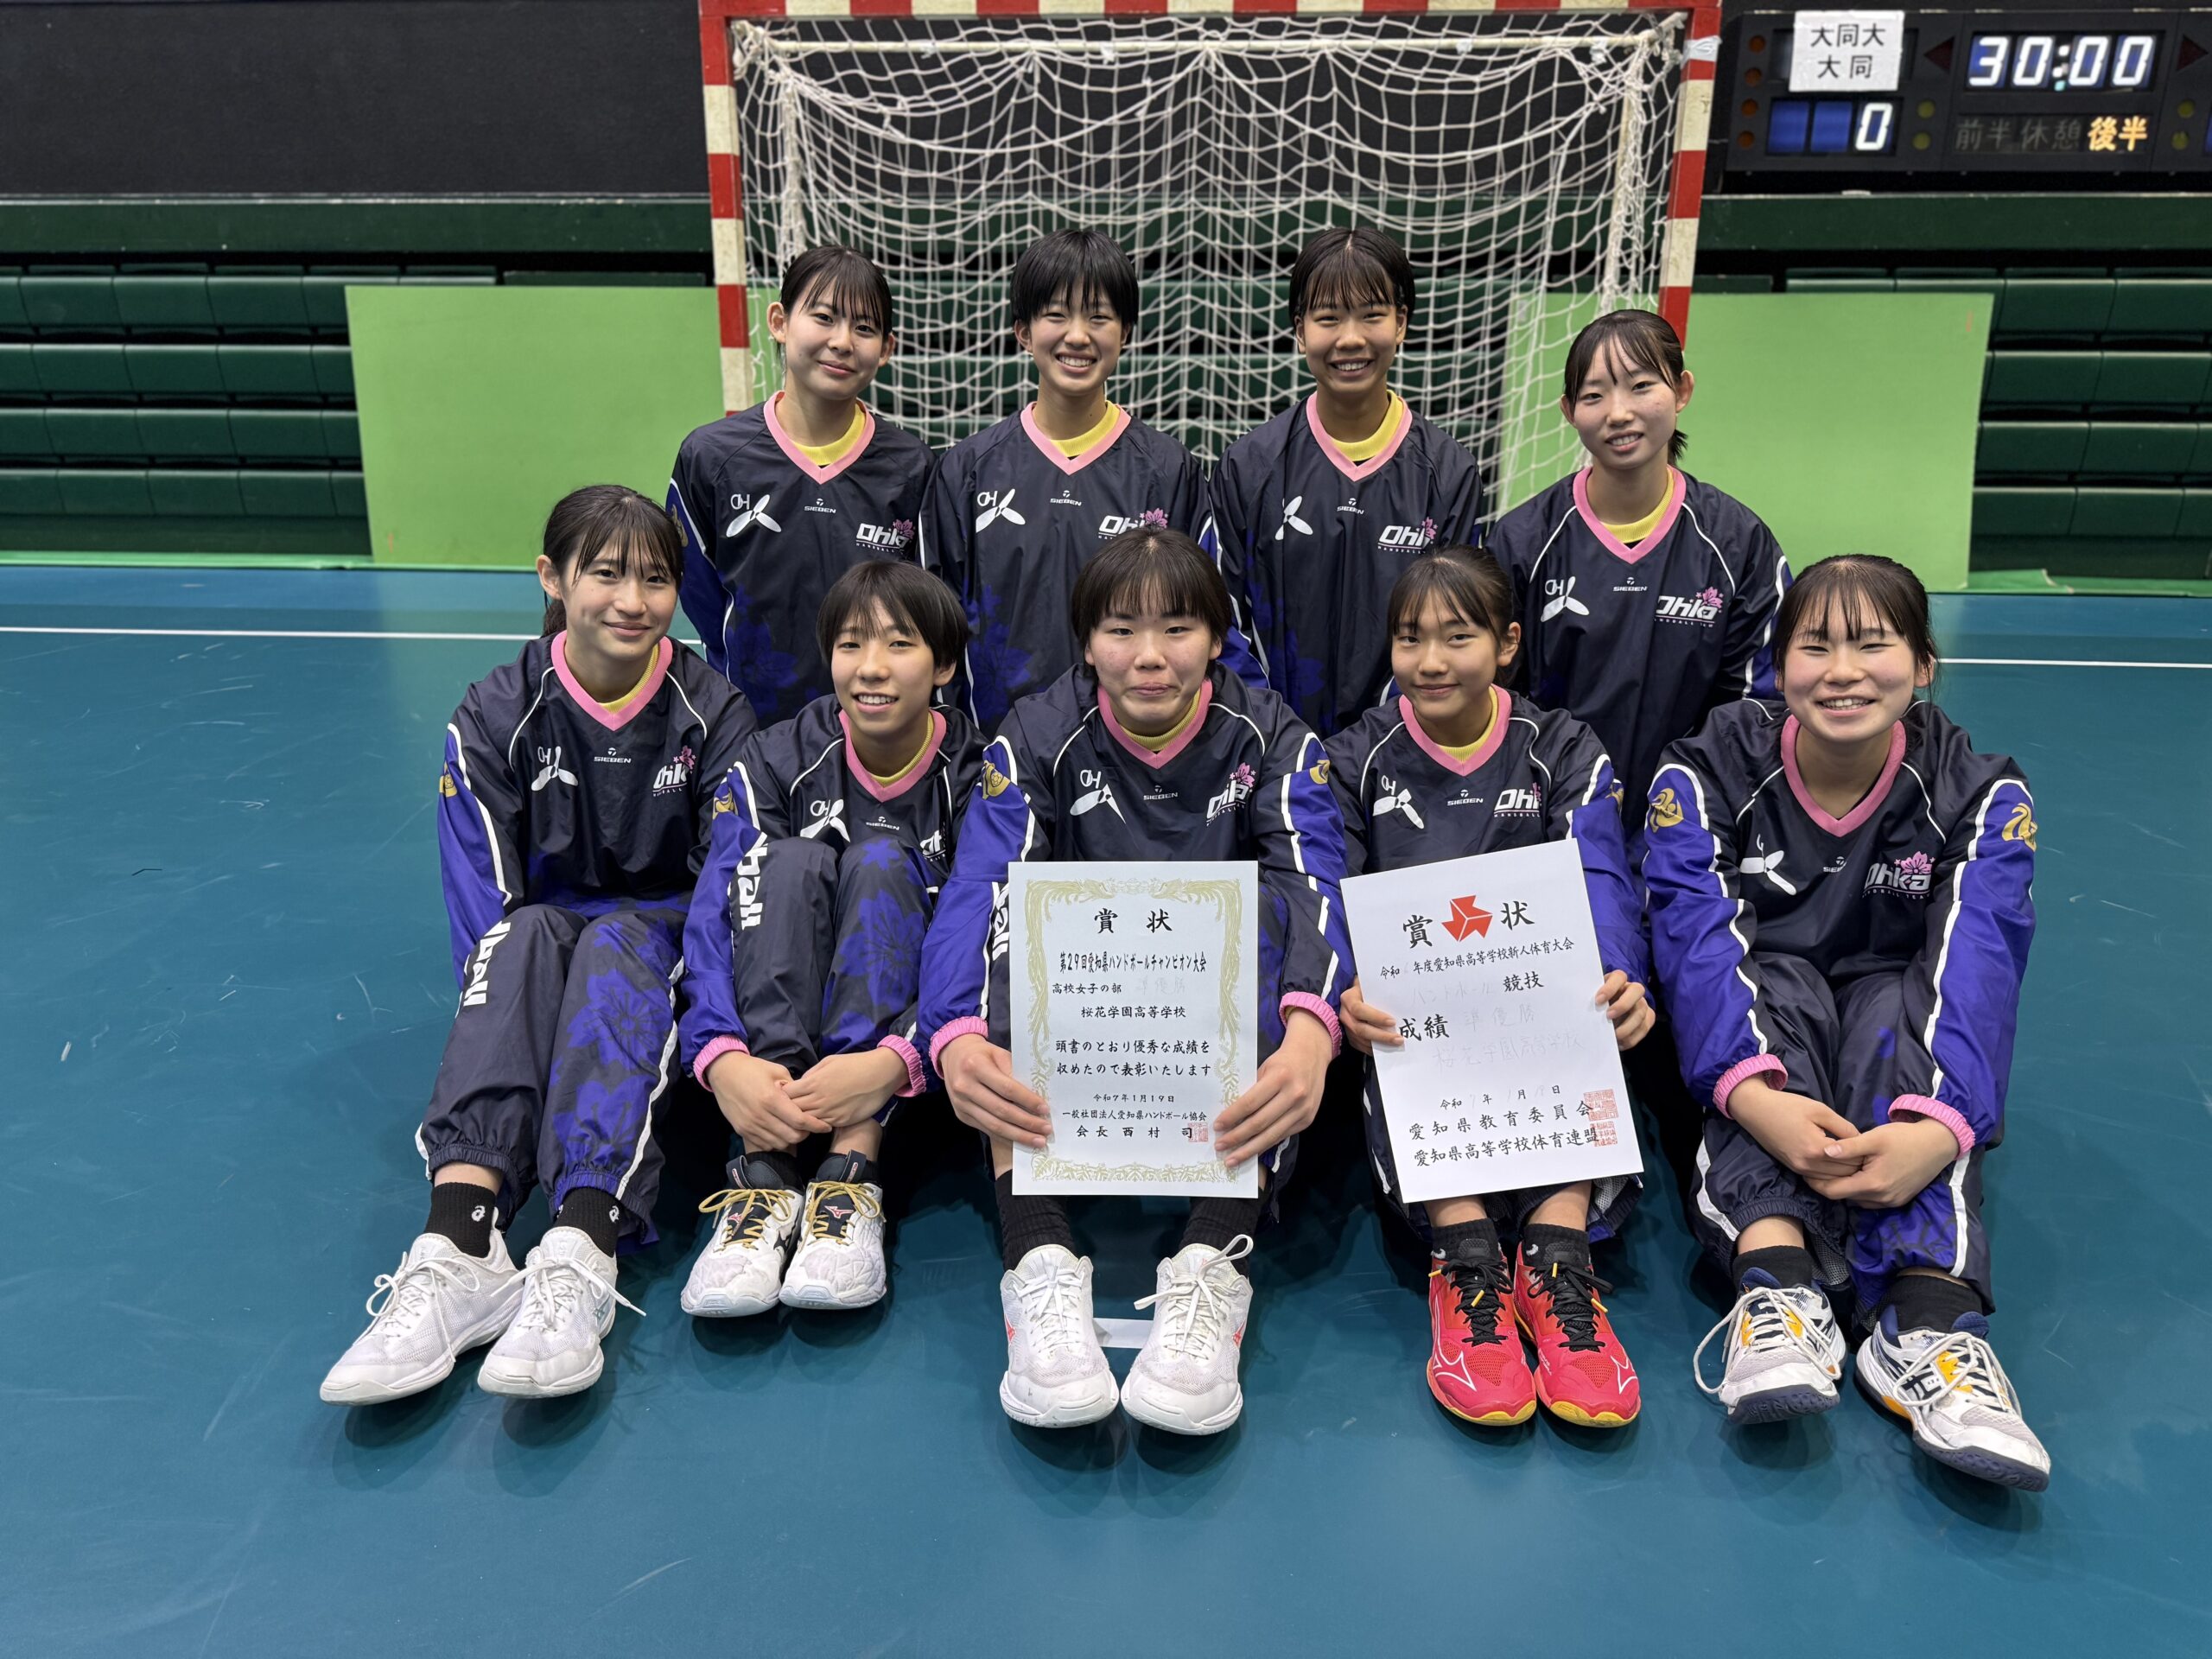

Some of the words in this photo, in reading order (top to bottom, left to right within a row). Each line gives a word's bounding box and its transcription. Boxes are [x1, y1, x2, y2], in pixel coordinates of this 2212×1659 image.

[1809, 22, 1885, 48] 大同大
[1968, 36, 2154, 86] 30:00
[1854, 103, 1893, 150] 0
[2088, 116, 2149, 151] 後半
[1143, 792, 1179, 801] SIEBEN
[1447, 798, 1484, 806] SIEBEN
[866, 822, 899, 830] SIEBEN
[1052, 982, 1122, 995] 高校女子の部
[1503, 970, 1544, 992] 競技
[1081, 1006, 1186, 1019] 桜花学園高等学校
[1399, 1014, 1450, 1041] 成績
[1056, 1039, 1210, 1054] 頭書のとおり優秀な成績を
[1057, 1061, 1211, 1077] 収めたので表彰いたします
[1062, 1109, 1207, 1122] 一般社団法人愛知県ハンドボール協会
[1409, 1100, 1593, 1141] 愛知県教育委員会
[1414, 1128, 1599, 1167] 愛知県高等学校体育連盟
